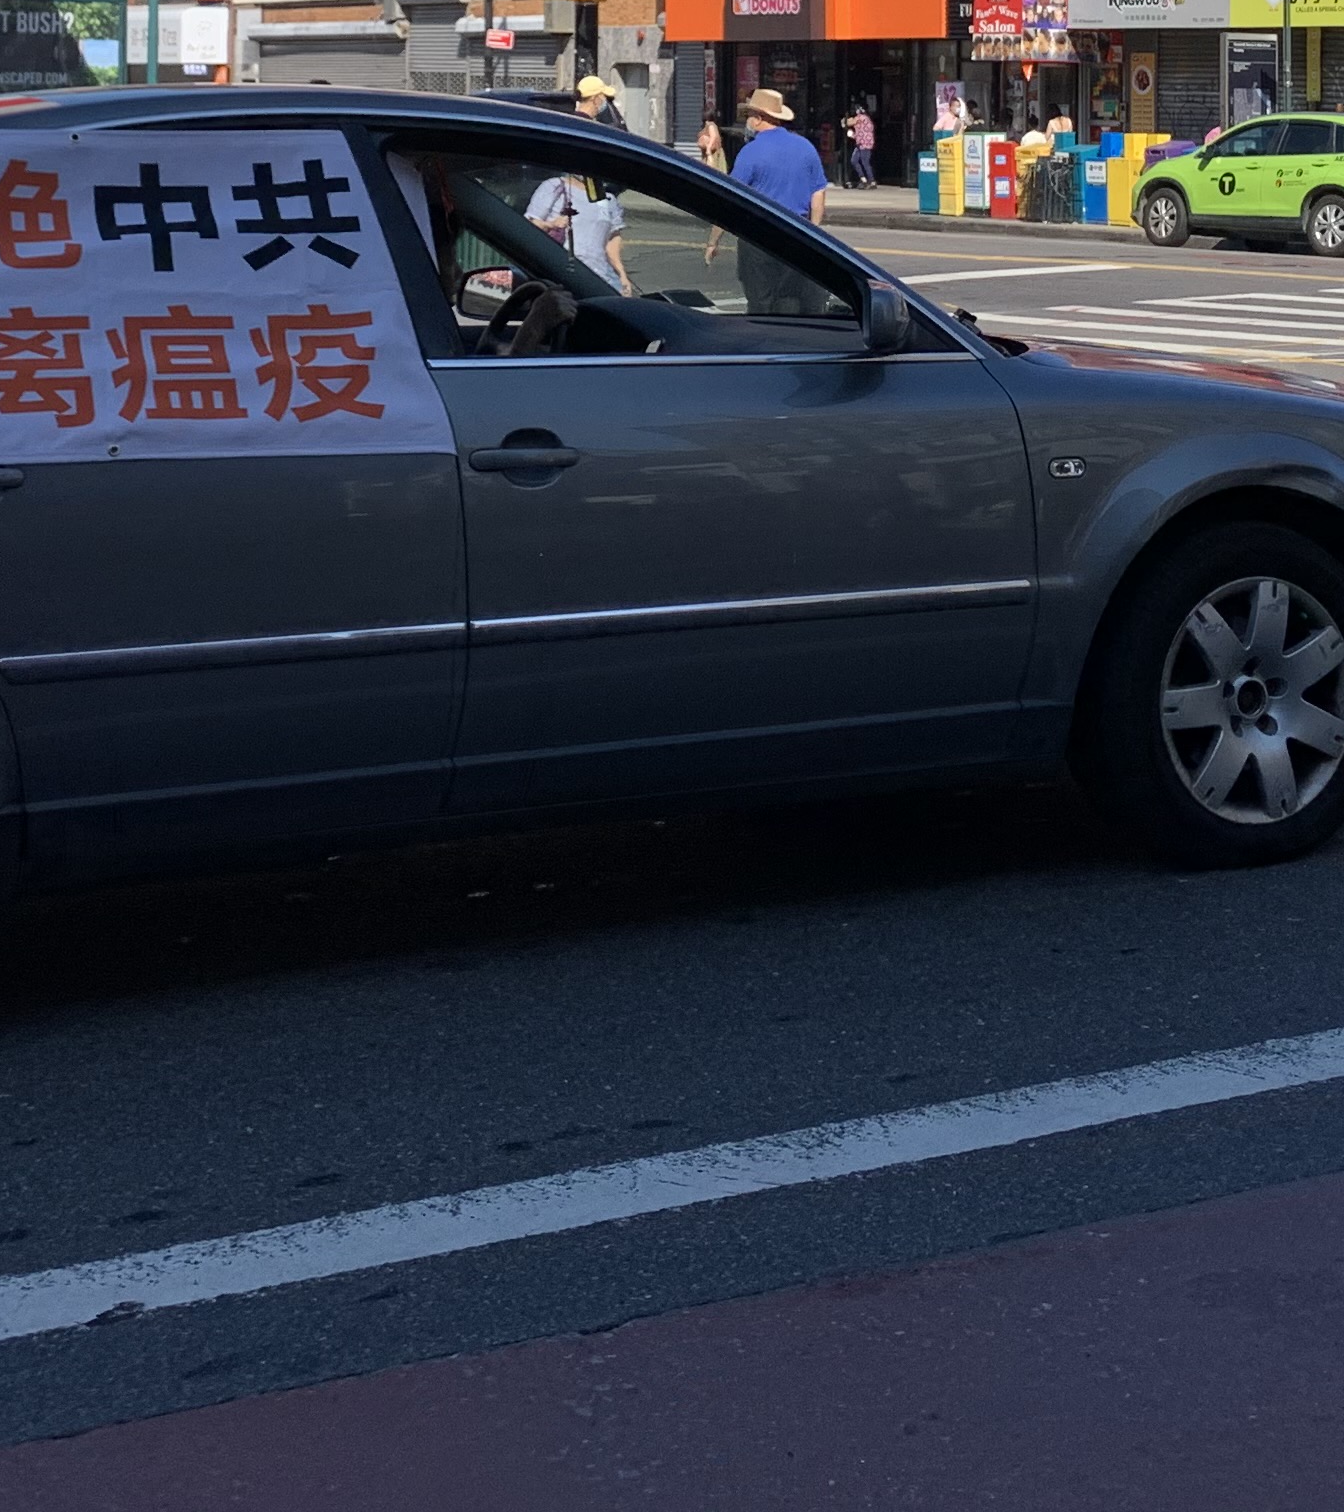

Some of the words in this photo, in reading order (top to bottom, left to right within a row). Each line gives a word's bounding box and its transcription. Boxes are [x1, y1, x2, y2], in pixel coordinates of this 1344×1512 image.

[976, 5, 997, 20] Fancy
[998, 5, 1018, 20] Wave
[16, 9, 75, 34] BUSH?
[978, 20, 1016, 33] Salon
